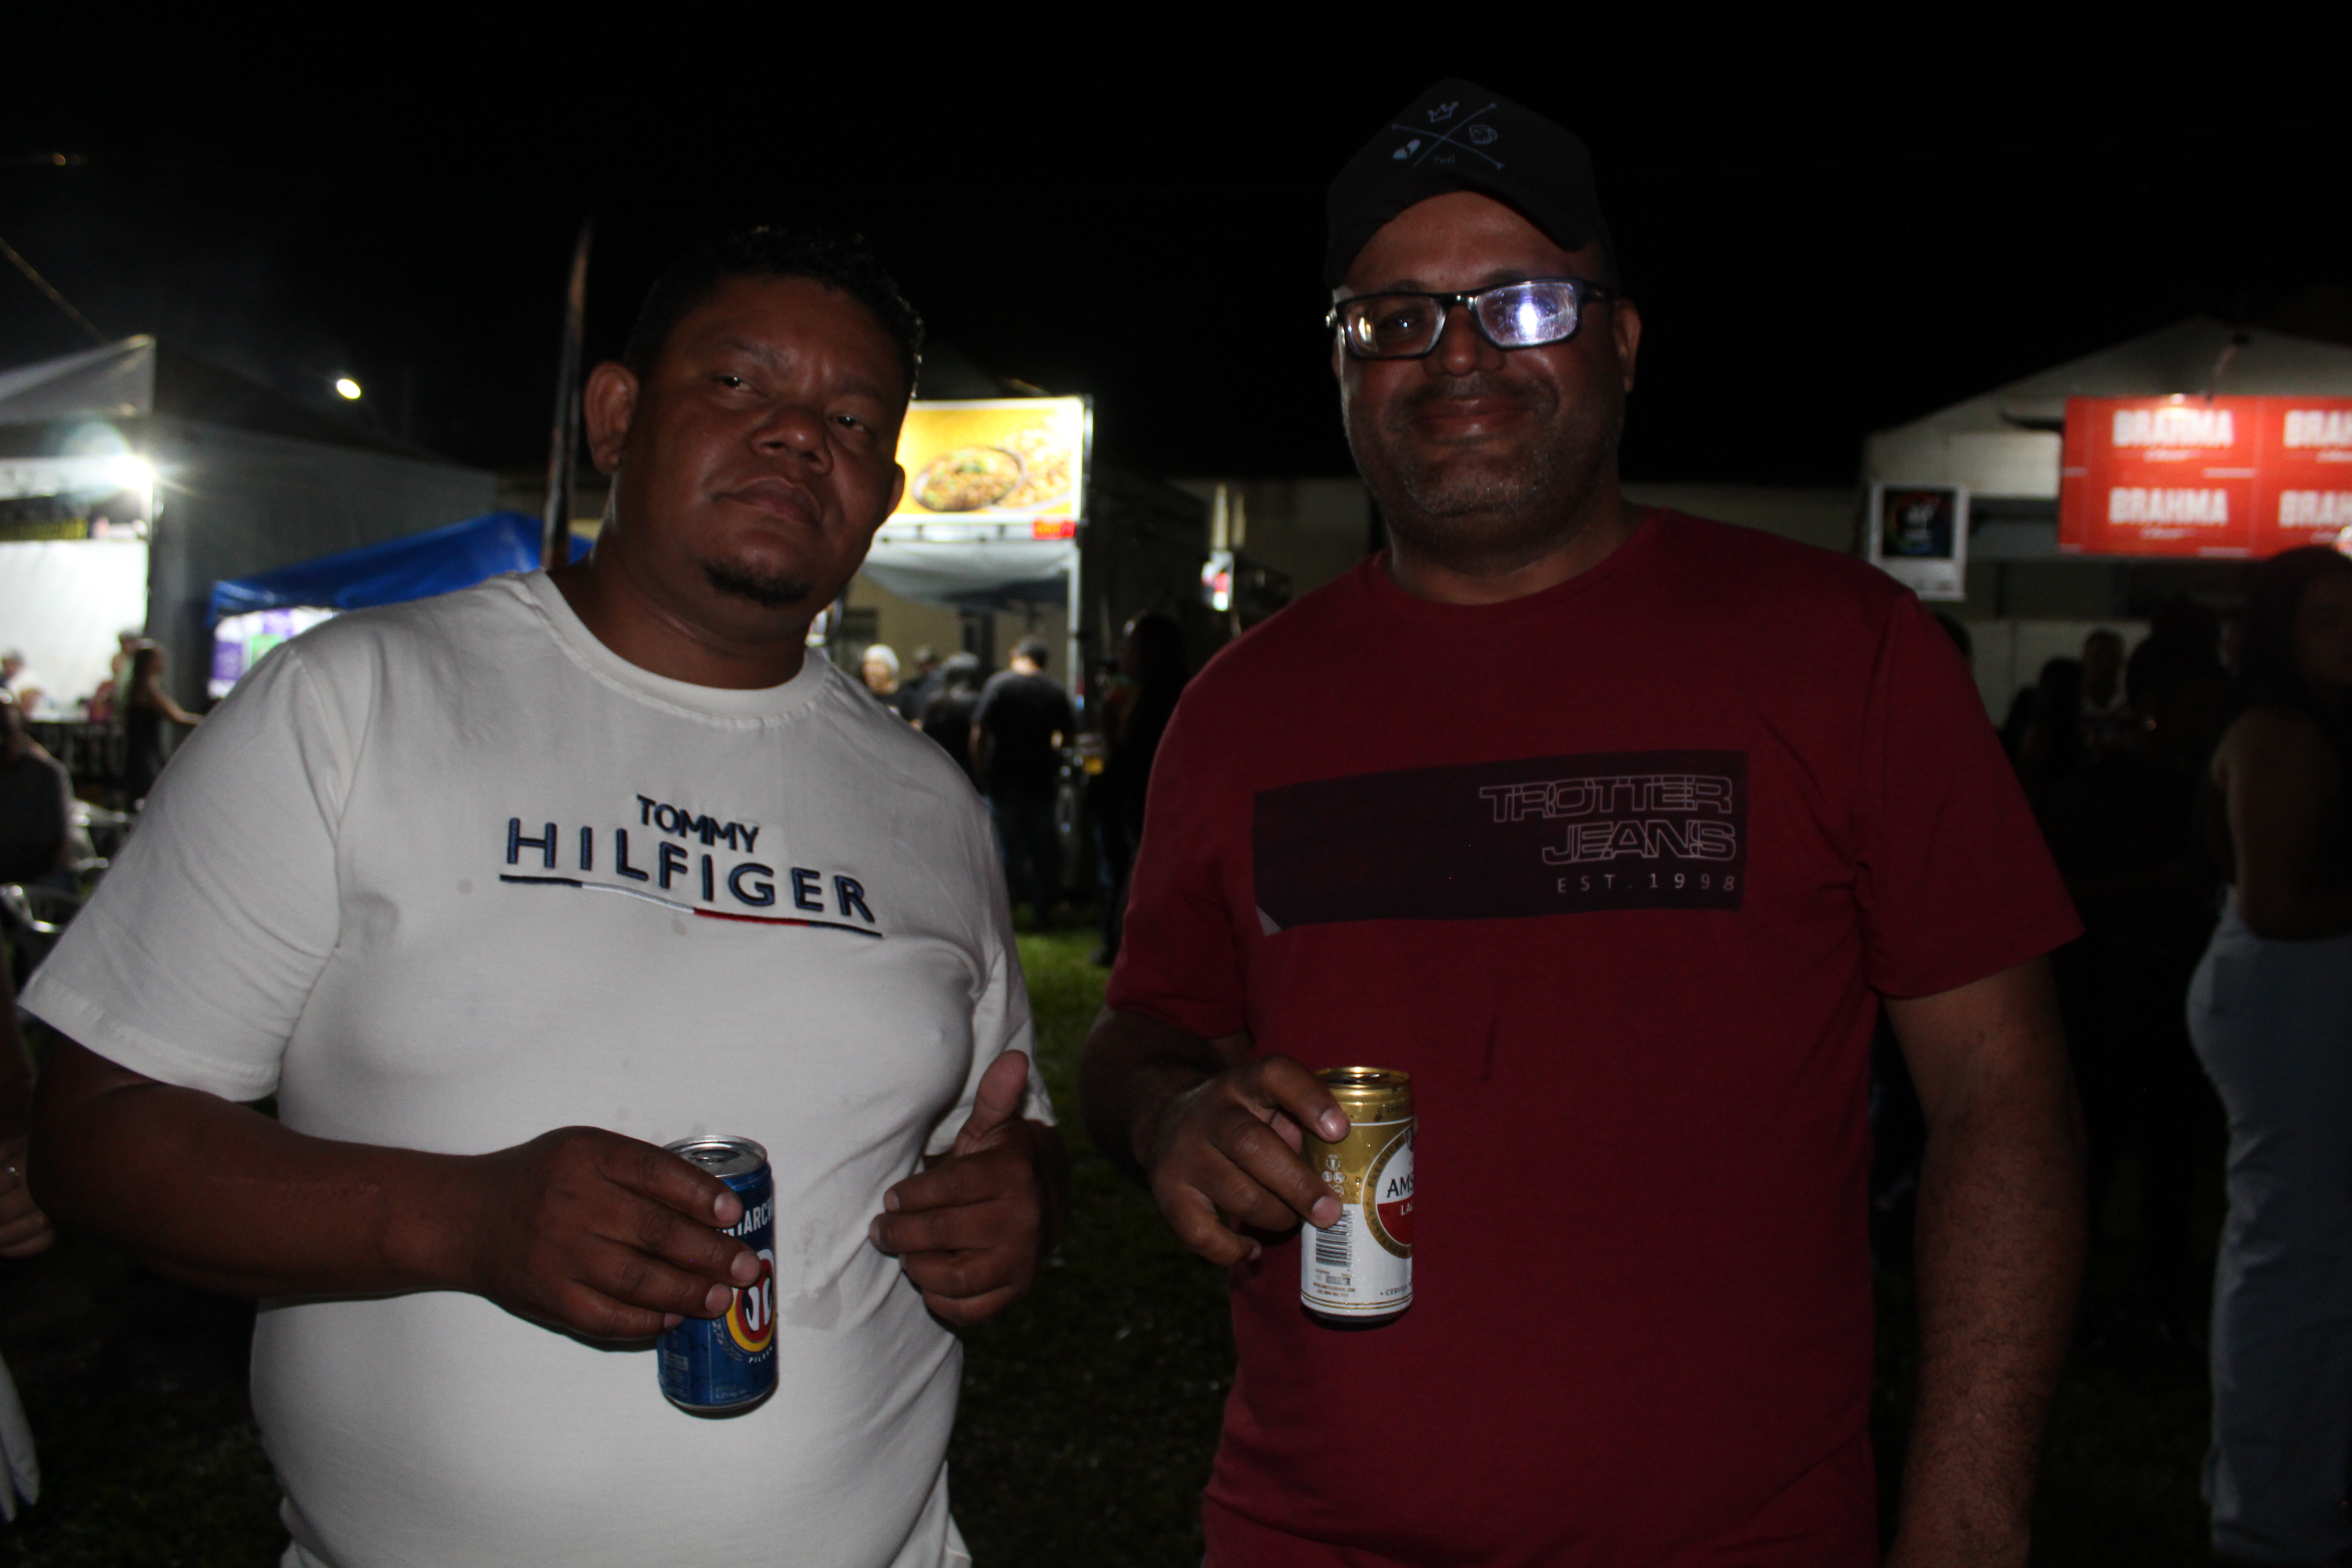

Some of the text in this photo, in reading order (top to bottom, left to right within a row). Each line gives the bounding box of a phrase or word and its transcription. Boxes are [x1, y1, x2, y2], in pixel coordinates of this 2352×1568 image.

[2112, 408, 2234, 447] BRAHMA
[2108, 487, 2229, 526] BRAHMA
[1479, 774, 1733, 823] TROTTER
[637, 794, 759, 854] TOMMY
[1542, 819, 1736, 865] JEANS
[507, 818, 875, 923] HILFIGER
